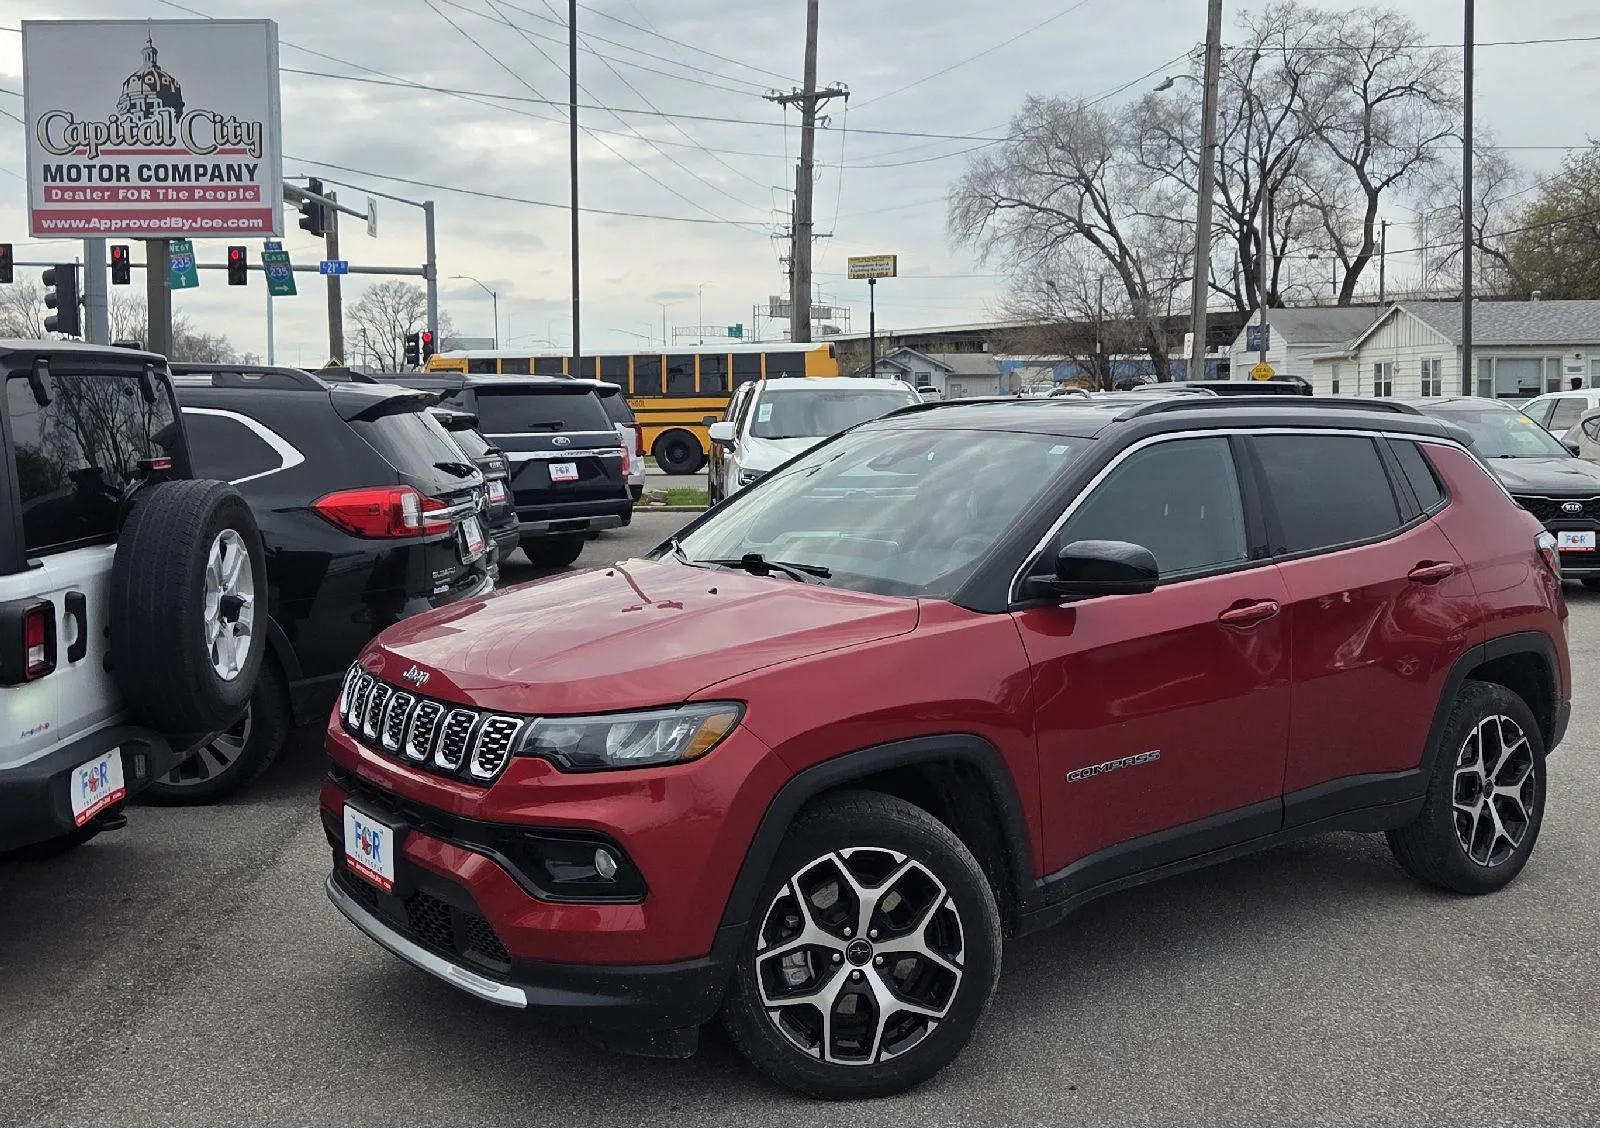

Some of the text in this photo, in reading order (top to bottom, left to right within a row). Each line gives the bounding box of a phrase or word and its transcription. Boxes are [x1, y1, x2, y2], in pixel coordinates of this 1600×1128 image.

[37, 109, 262, 160] Capital City
[43, 163, 259, 183] MOTOR COMPANY
[51, 187, 255, 201] Dealer FOR The People
[41, 216, 263, 231] www.ApprovedByJoe.com
[171, 258, 191, 269] 235
[264, 253, 287, 261] EAST
[269, 265, 289, 277] 235
[1566, 535, 1586, 544] FOR
[402, 664, 431, 688] Jeep
[1066, 750, 1161, 783] COMPASS
[81, 761, 109, 799] FOR
[354, 820, 382, 863] FOR
